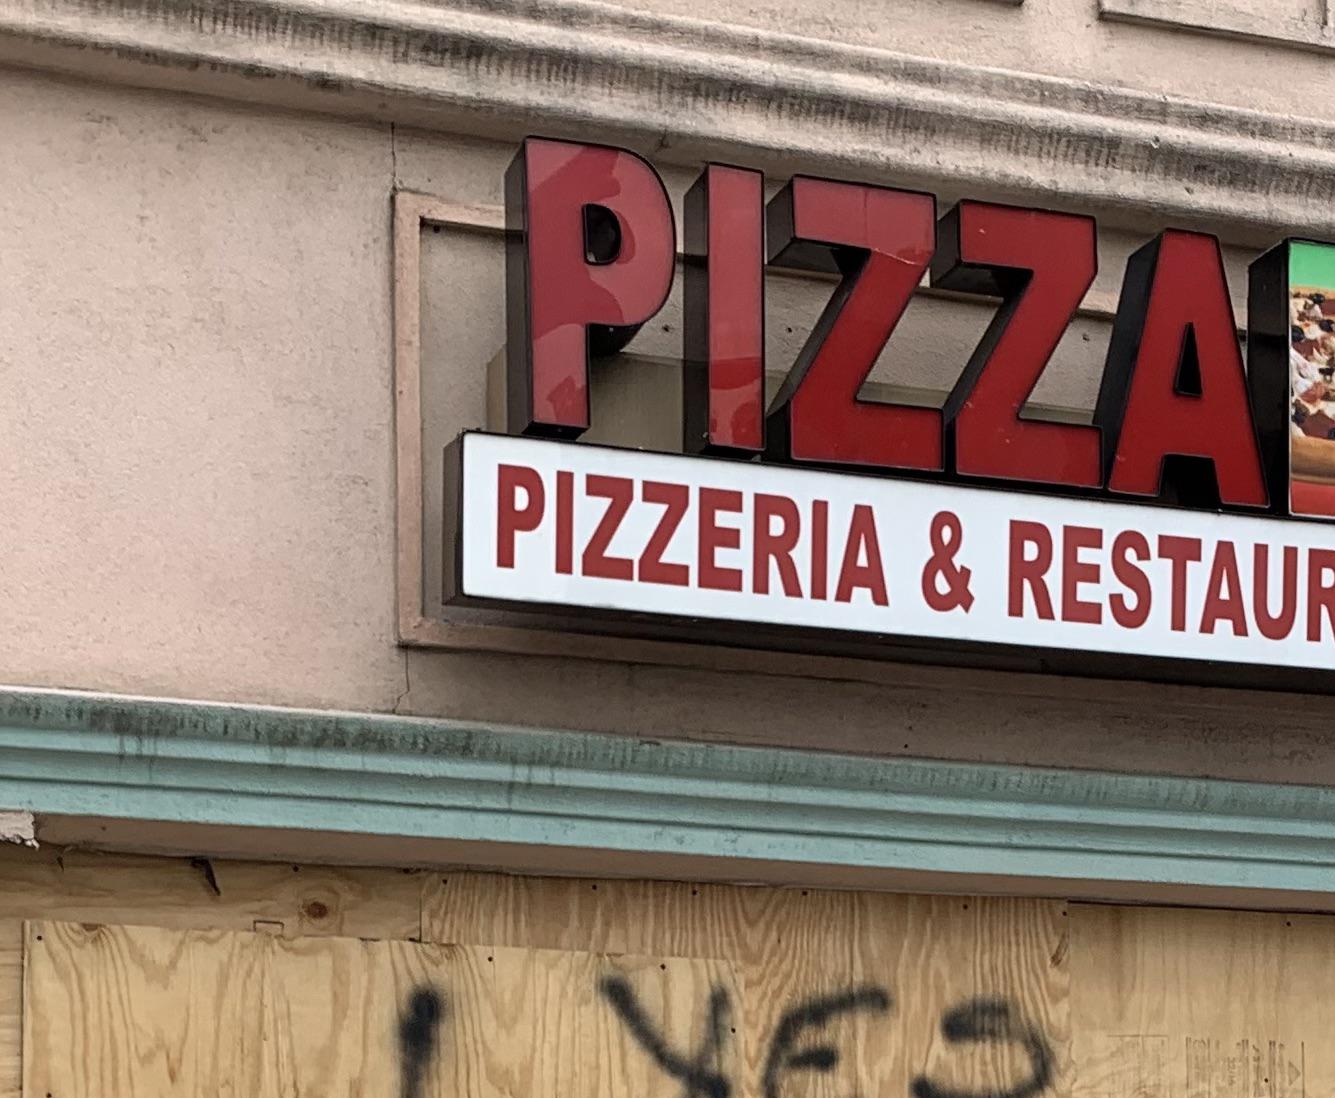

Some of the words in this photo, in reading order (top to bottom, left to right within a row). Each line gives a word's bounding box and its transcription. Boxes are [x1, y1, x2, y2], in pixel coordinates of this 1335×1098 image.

[524, 136, 1270, 508] PIZZA
[496, 463, 889, 608] PIZZERIA
[920, 510, 976, 615] &
